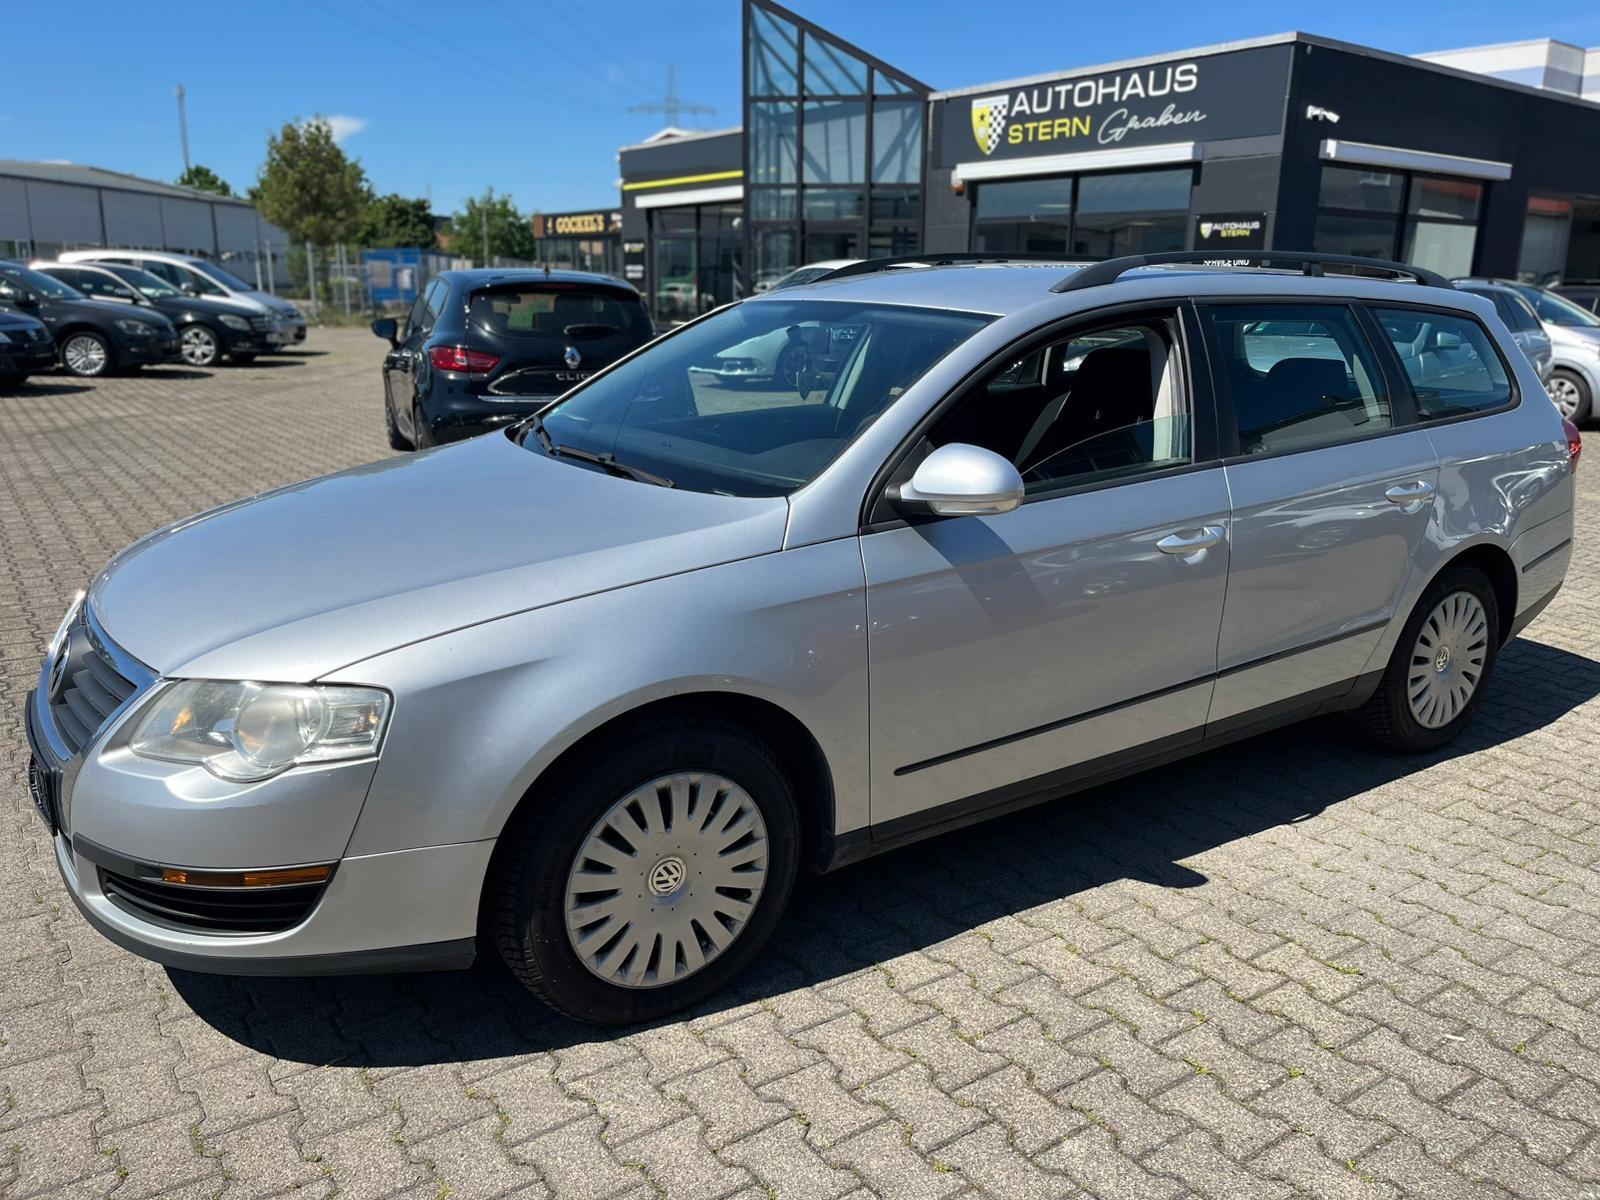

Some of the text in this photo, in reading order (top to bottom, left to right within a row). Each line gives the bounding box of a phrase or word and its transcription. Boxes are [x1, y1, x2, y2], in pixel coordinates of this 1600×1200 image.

[1011, 64, 1198, 116] AUTOHAUS
[1008, 103, 1208, 145] STERN Graben
[1212, 221, 1260, 230] AUTOHAUS
[1220, 229, 1250, 237] STERN
